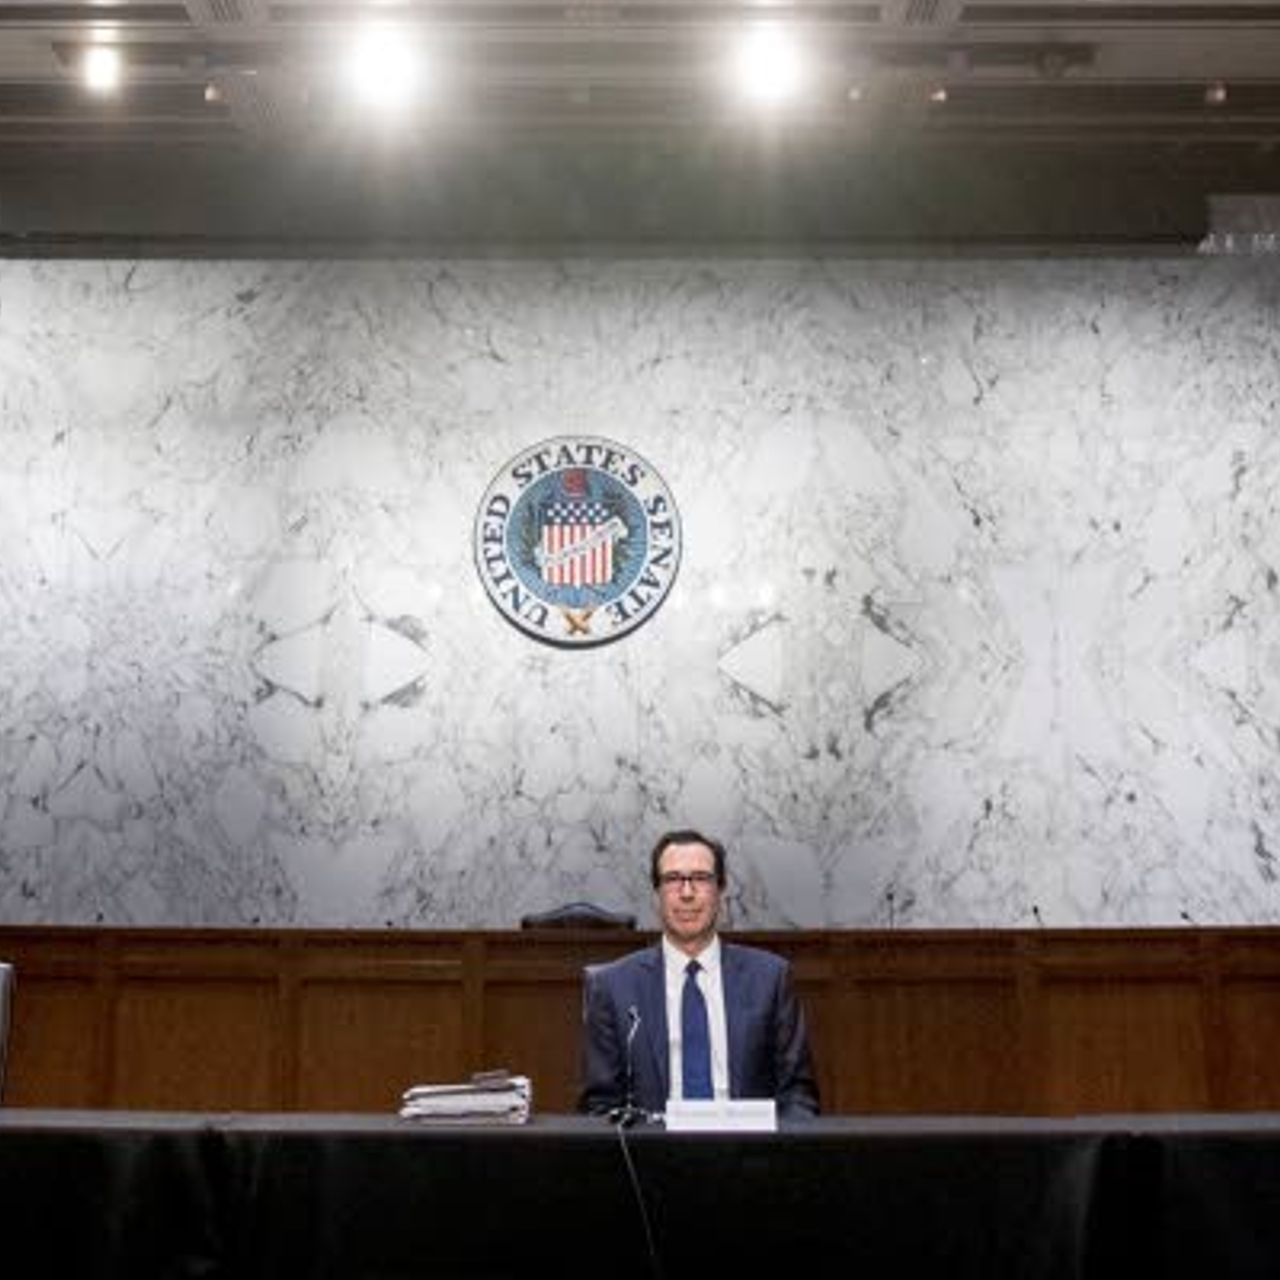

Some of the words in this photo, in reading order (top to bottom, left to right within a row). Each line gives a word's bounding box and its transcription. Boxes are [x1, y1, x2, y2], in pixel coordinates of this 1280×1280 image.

[512, 444, 645, 487] STATES
[483, 494, 549, 627] UNITED
[606, 494, 674, 625] SENATE
